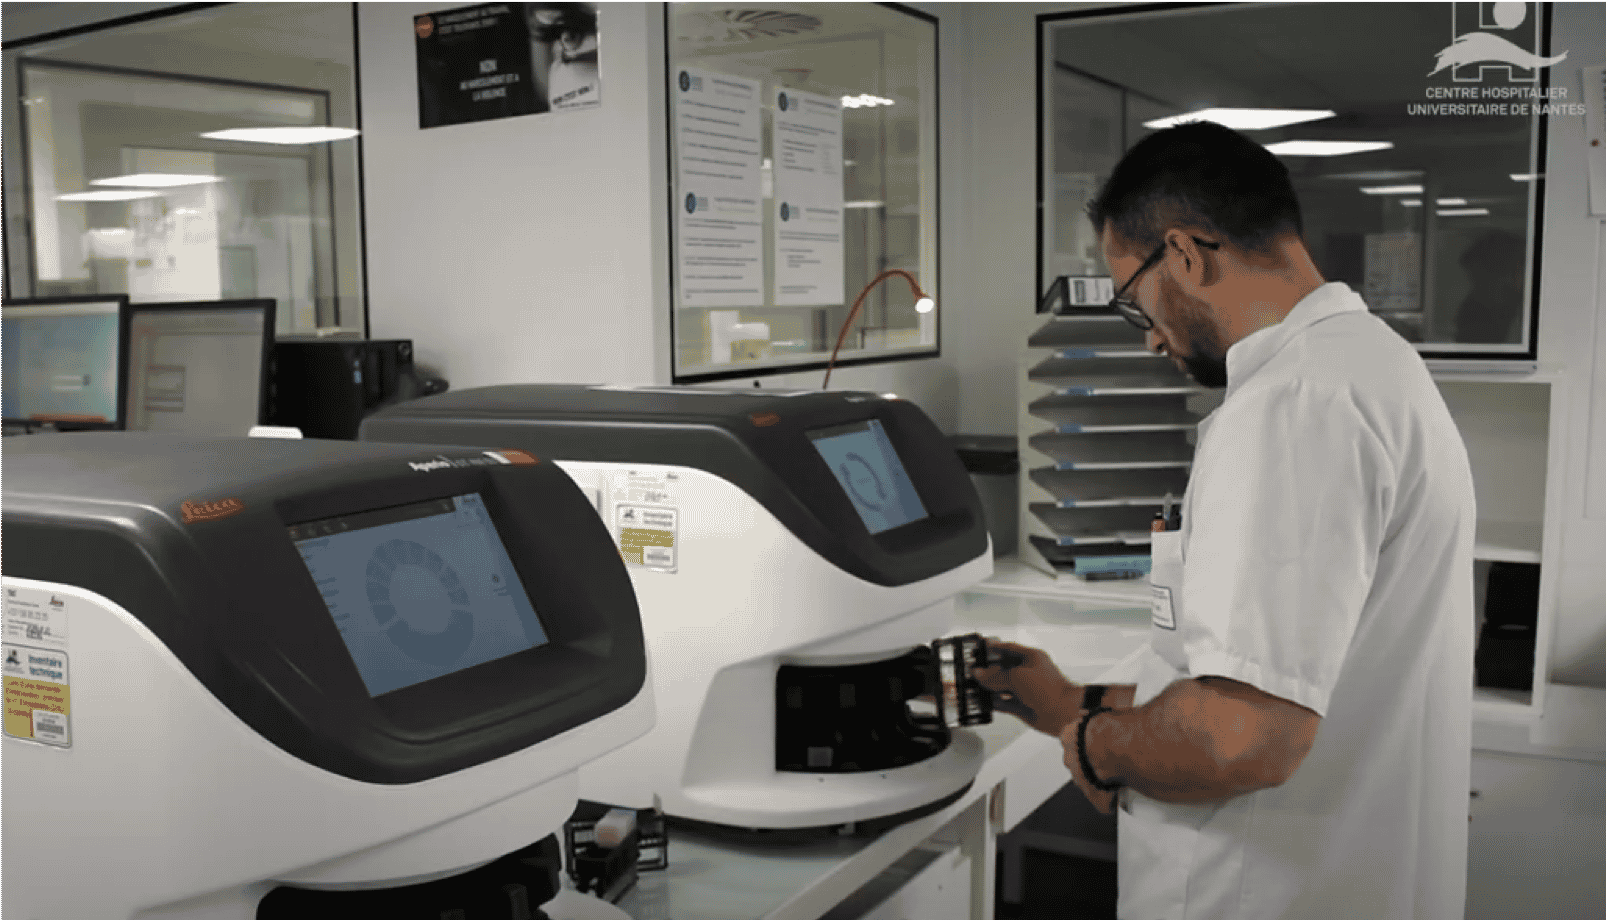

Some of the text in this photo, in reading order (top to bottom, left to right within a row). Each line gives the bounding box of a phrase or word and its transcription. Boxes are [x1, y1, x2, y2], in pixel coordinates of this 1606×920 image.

[180, 498, 244, 524] Leica
[28, 653, 62, 668] Inventaire
[28, 665, 63, 680] technique
